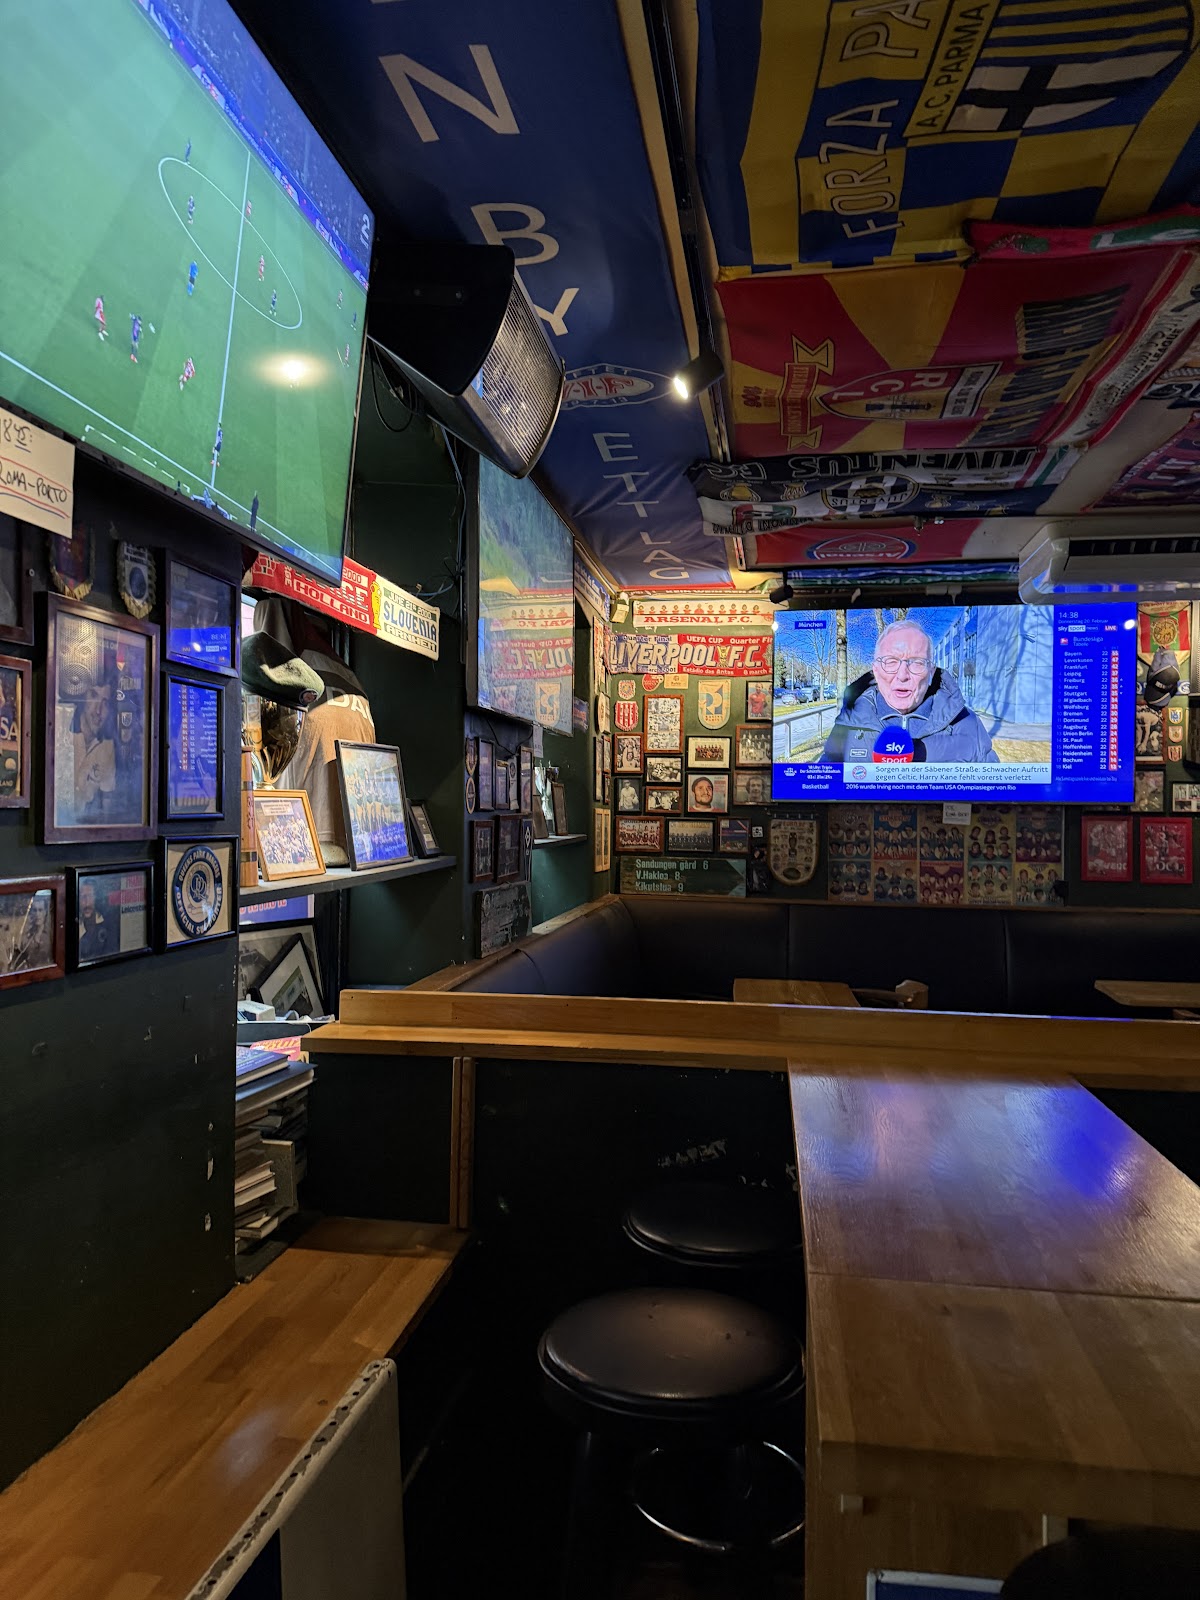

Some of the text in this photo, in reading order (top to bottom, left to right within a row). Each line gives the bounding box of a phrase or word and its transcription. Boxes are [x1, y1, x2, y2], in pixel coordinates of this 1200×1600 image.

[920, 3, 985, 131] A.C. PARMA
[818, 99, 904, 240] FORZA
[789, 447, 1038, 478] JUVENTUS
[831, 491, 908, 507] JUVENTUS
[819, 551, 901, 562] Arsenal
[296, 581, 368, 623] HOLLAND
[390, 592, 406, 606] JUNE
[384, 600, 437, 643] SLOVENIA
[643, 616, 752, 624] ARSENAL F.C.
[798, 621, 824, 629] München
[387, 626, 436, 653] ARNHEM
[610, 643, 762, 669] LIVERPOOL F.C.
[886, 742, 904, 753] sky
[881, 755, 907, 763] sport
[876, 766, 899, 774] Sorgen
[178, 849, 221, 882] QUEENS PARK RANGERS
[635, 859, 677, 870] Sandungen
[702, 860, 709, 870] 6
[674, 872, 681, 880] 8
[677, 882, 684, 892] 9
[176, 891, 194, 934] OFFICIAL
